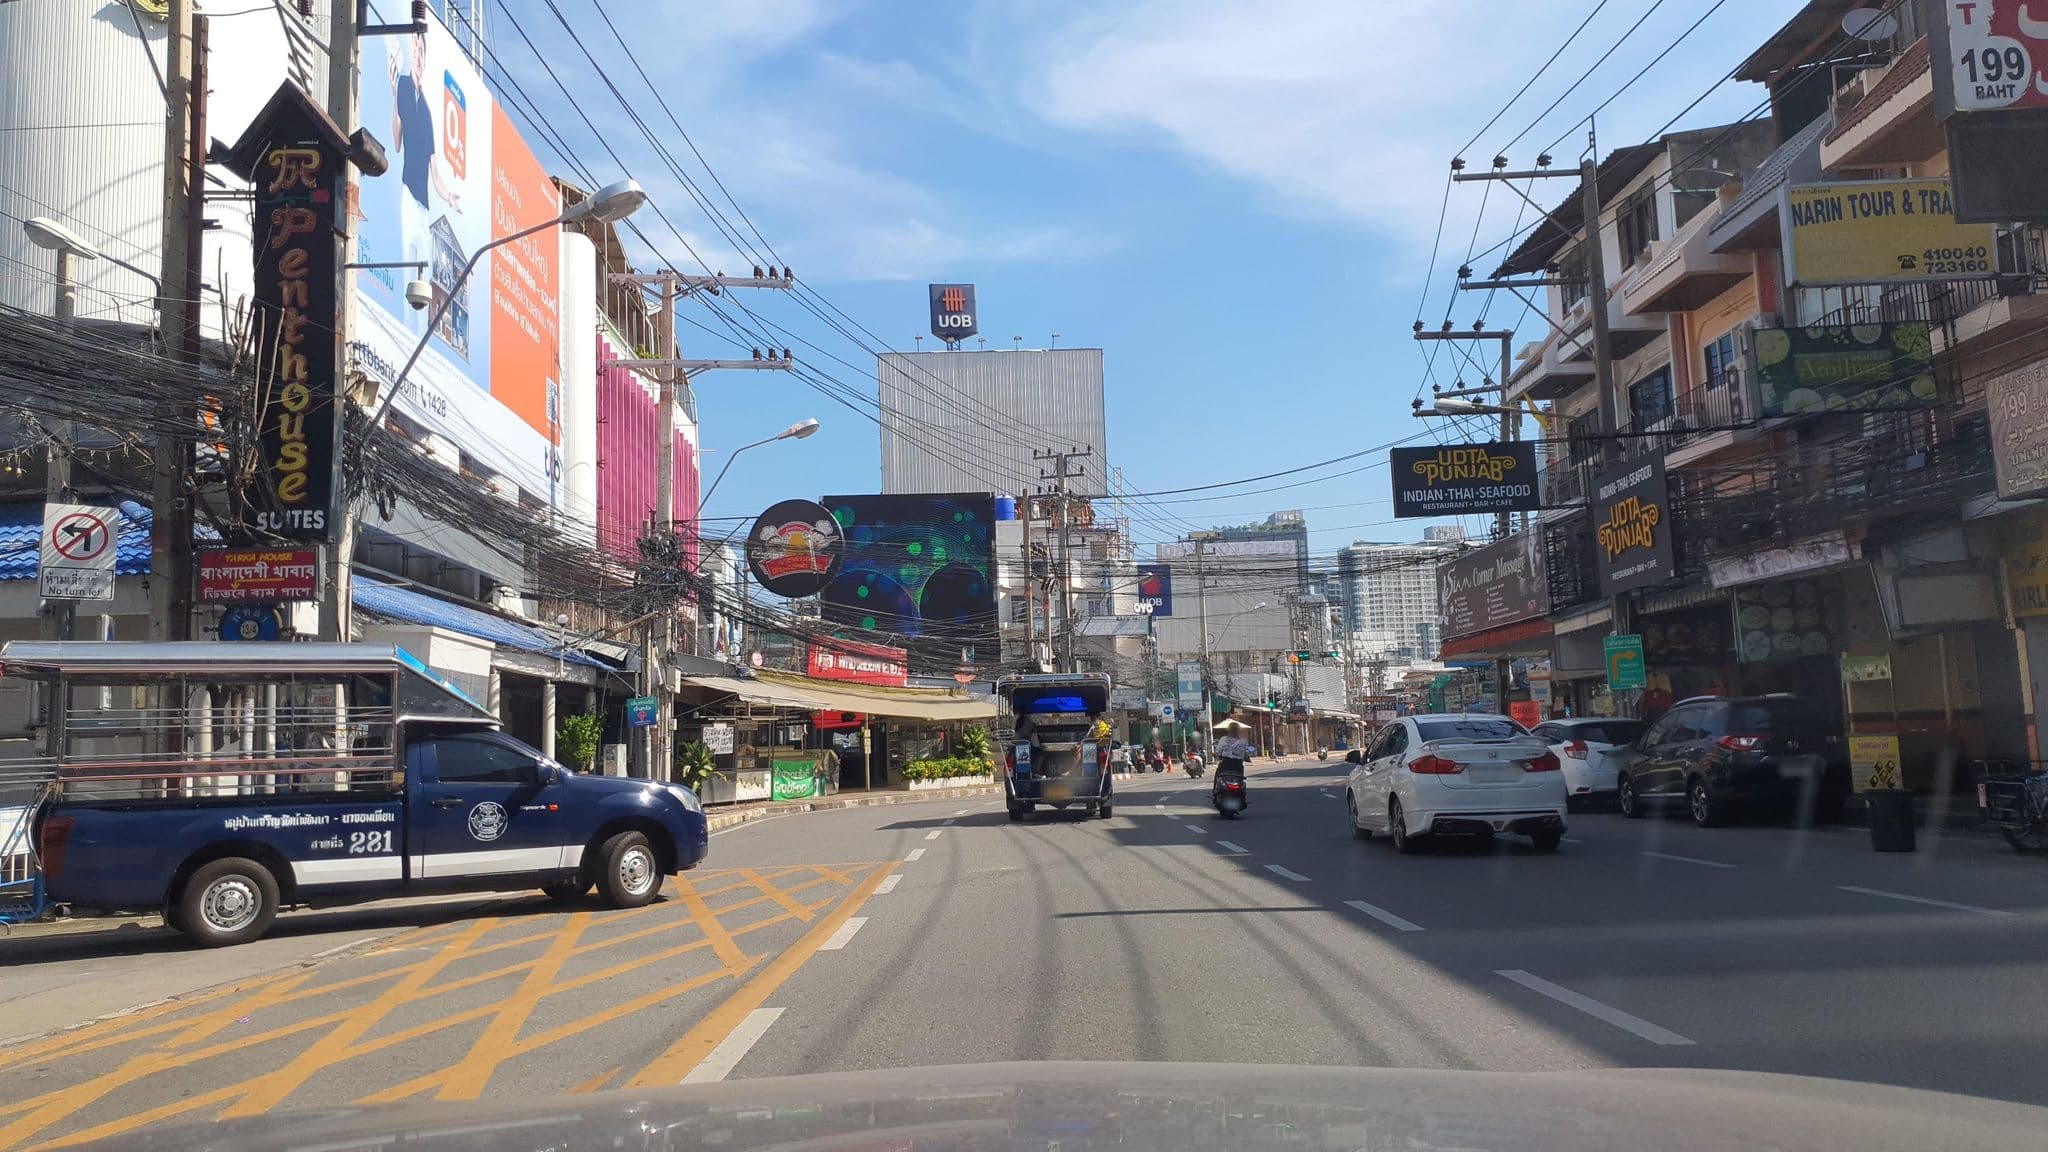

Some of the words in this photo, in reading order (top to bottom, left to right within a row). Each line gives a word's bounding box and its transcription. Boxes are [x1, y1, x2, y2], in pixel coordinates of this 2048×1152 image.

[1961, 47, 2025, 82] 199
[1975, 85, 2016, 99] BAHT
[1791, 196, 1843, 228] NARIN
[1848, 190, 1896, 219] TOUR
[1902, 189, 1915, 215] &
[1923, 246, 1987, 260] 410040
[1926, 260, 1989, 274] 723160
[938, 314, 973, 328] UOB
[427, 394, 447, 418] 1428
[2001, 391, 2027, 420] 199
[1438, 448, 1490, 466] UDTA
[1426, 460, 1504, 487] PUNJAB
[1599, 481, 1616, 500] INDIAN
[1616, 477, 1629, 492] THAI
[1629, 464, 1653, 487] SEAFOOD
[1403, 489, 1443, 502] INDIAN
[1447, 488, 1475, 500] THAI
[1479, 484, 1531, 498] SEAFOOD
[1422, 501, 1469, 510] RESTAURANT
[1474, 500, 1489, 508] BAR
[1610, 495, 1641, 528] UDTA
[1605, 513, 1653, 563] PUNJAB
[260, 552, 294, 562] HOUSE
[1472, 567, 1494, 587] Corner
[48, 586, 62, 595] No
[65, 588, 86, 596] turn
[1134, 603, 1153, 613] OYO
[1142, 598, 1163, 606] UOB
[350, 830, 394, 854] 281
